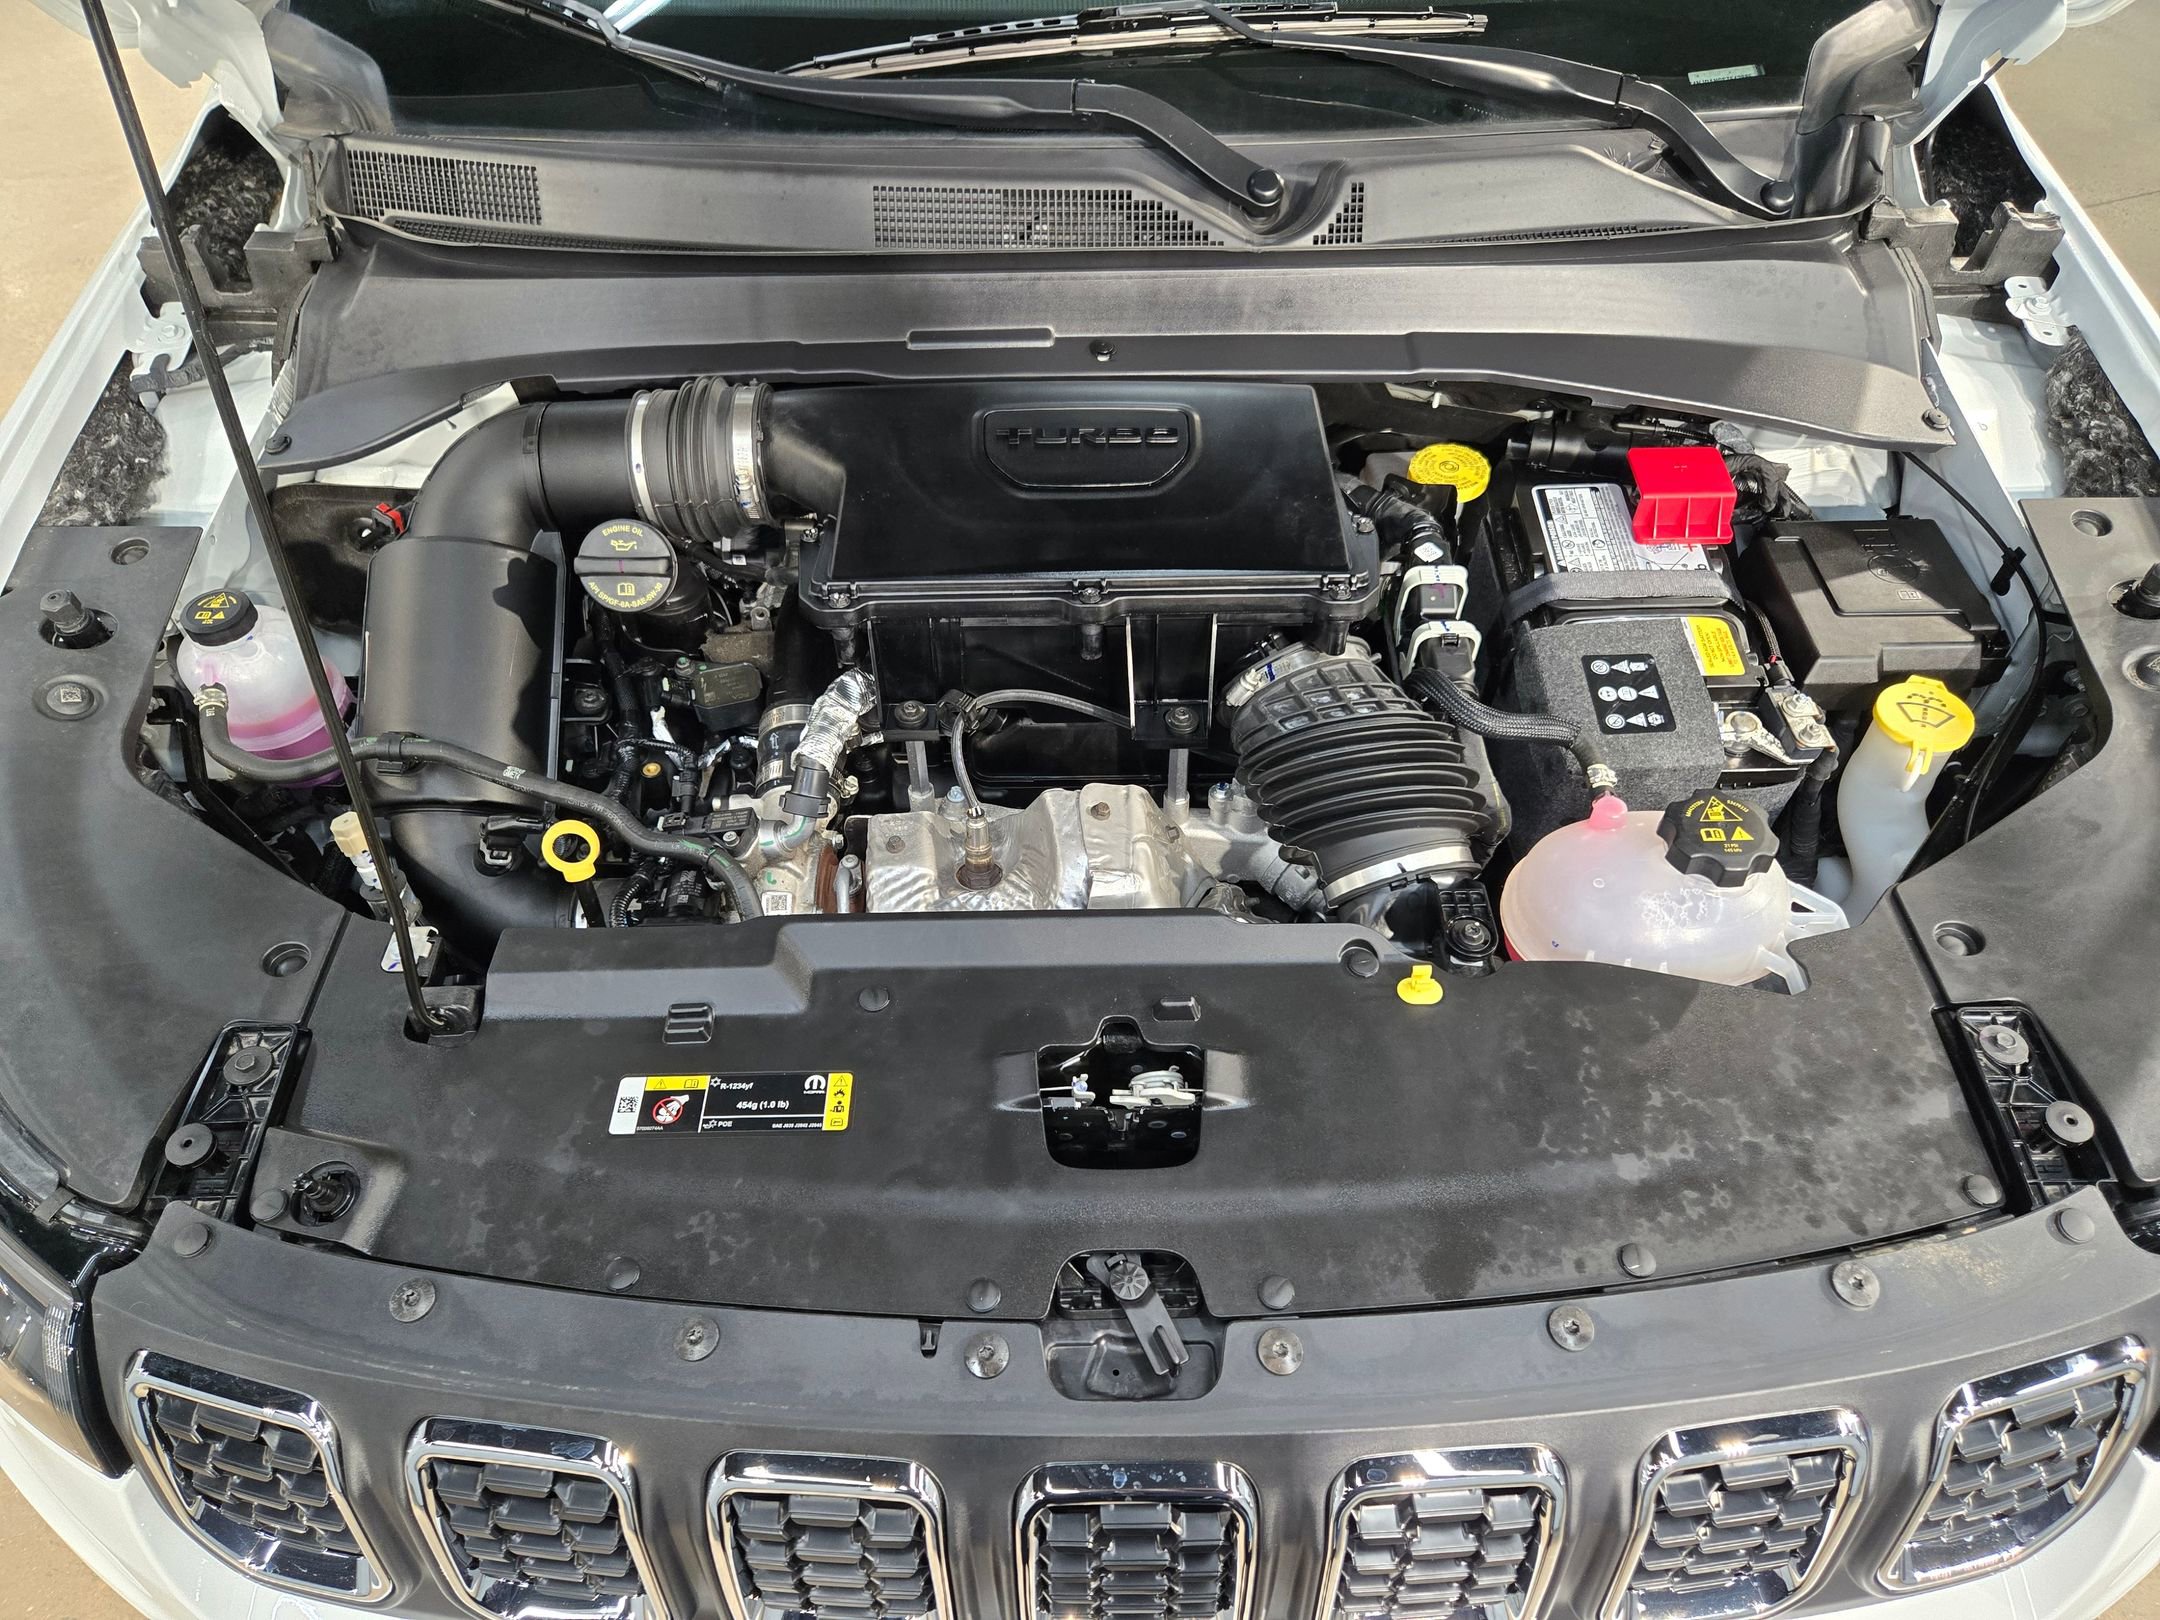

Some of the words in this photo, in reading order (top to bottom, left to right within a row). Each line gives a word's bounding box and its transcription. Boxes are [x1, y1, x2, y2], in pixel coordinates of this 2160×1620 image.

[996, 427, 1180, 445] TURBO
[602, 525, 631, 537] ENGINE
[631, 527, 644, 537] OIL
[588, 581, 600, 595] API
[720, 1082, 754, 1091] R-1234yf
[736, 1101, 758, 1110] 454g
[759, 1100, 775, 1110] (1.0
[777, 1100, 790, 1109] lb)
